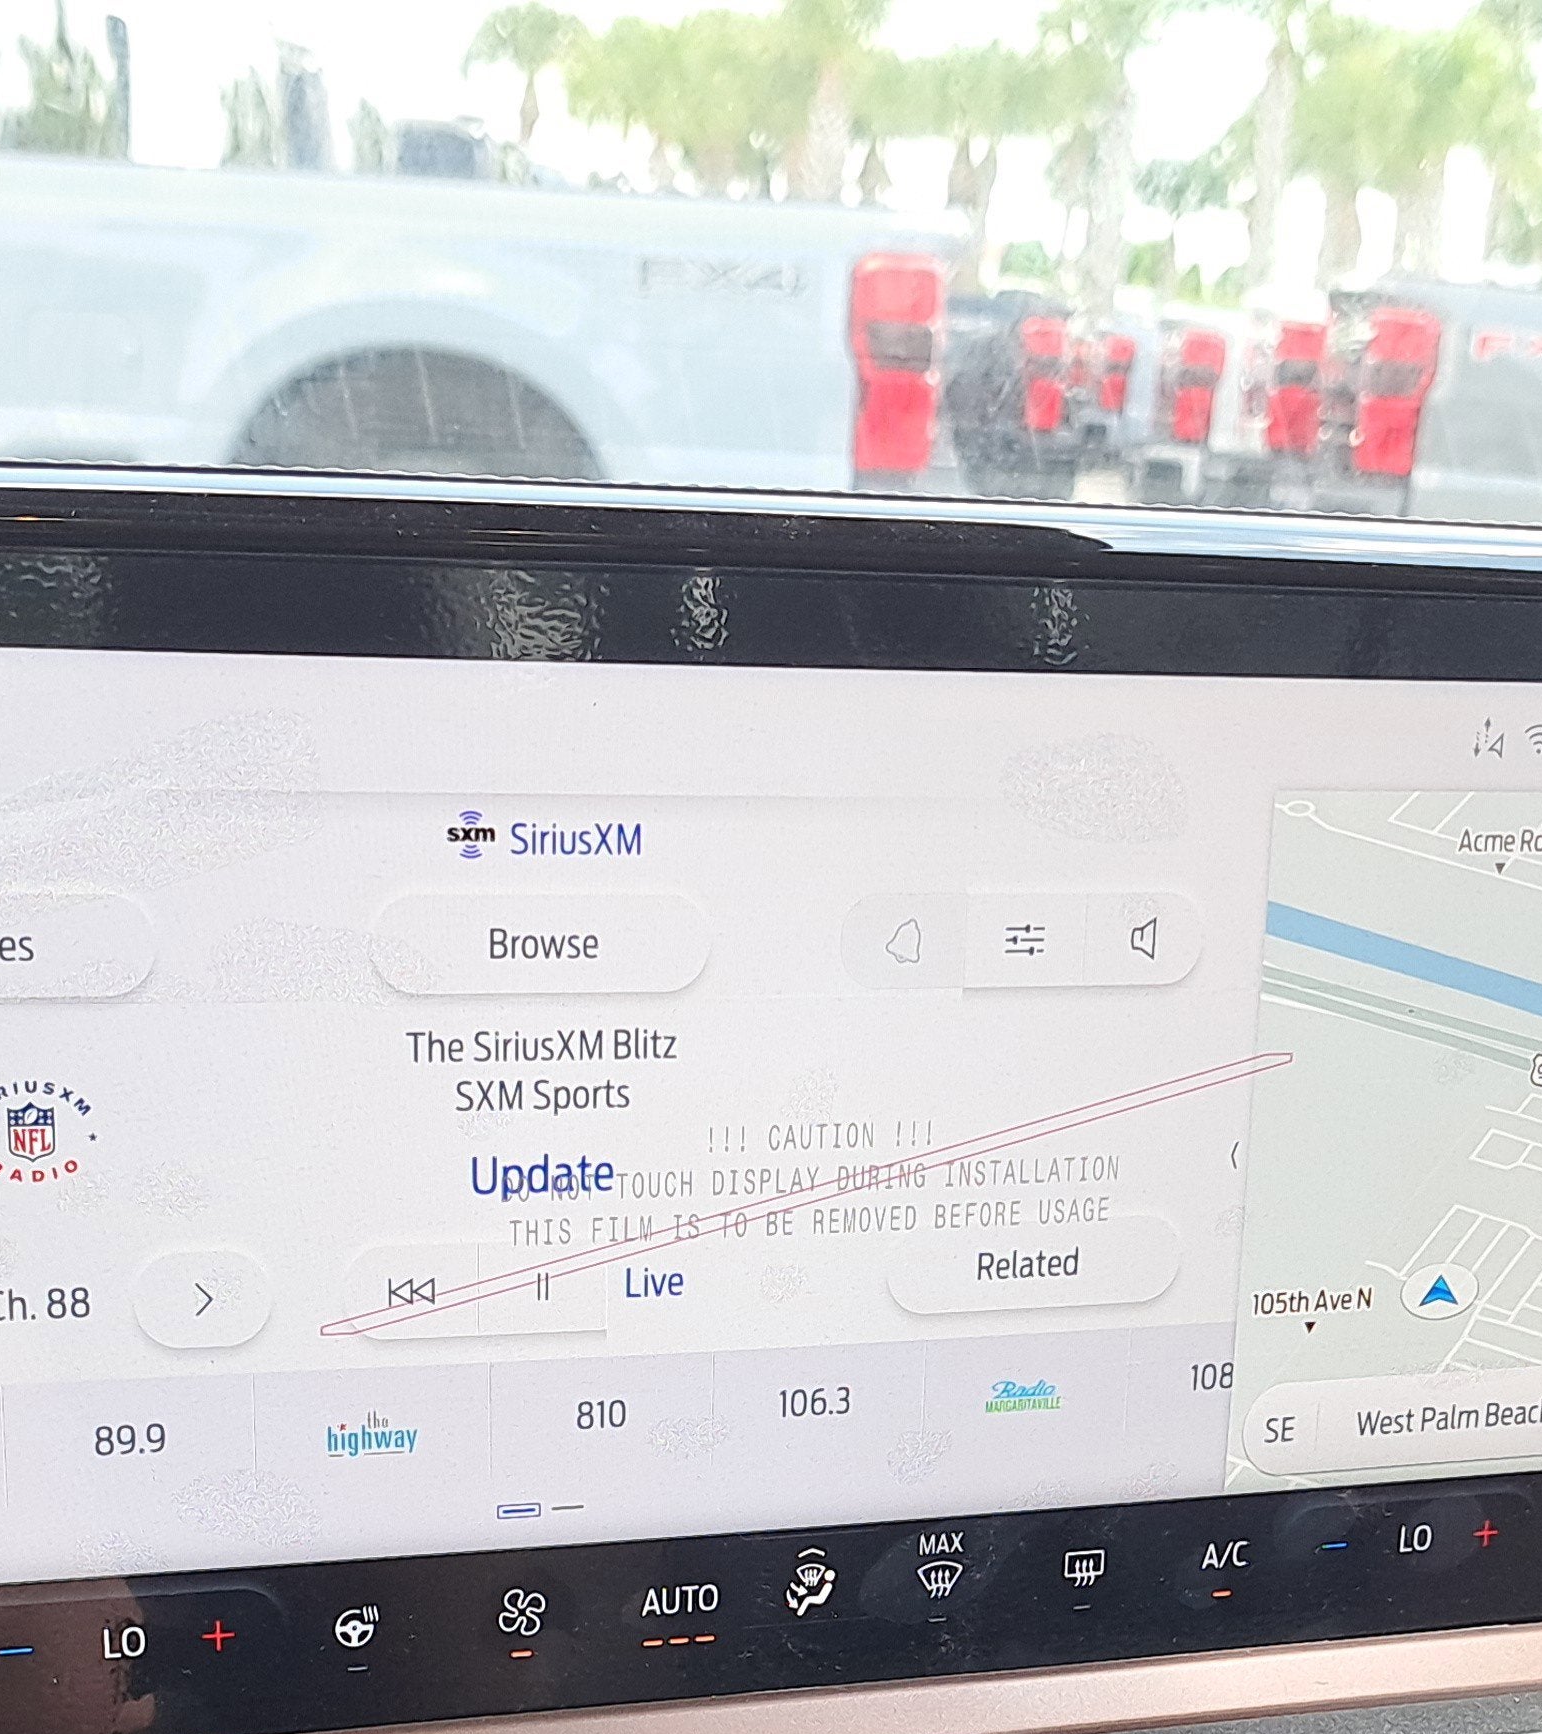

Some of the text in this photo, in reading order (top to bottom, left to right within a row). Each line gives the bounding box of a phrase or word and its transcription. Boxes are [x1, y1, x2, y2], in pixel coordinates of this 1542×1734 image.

[447, 826, 495, 842] sxm
[511, 823, 641, 855] SiriusXM
[1459, 829, 1515, 853] Acme
[490, 928, 599, 959] Browse
[406, 1028, 678, 1063] The SiriusXM Blitz
[456, 1079, 630, 1116] SXM Sports
[13, 1129, 51, 1155] NFL
[709, 1120, 932, 1152] !!! CAUTION !!!
[471, 1154, 613, 1200] Update
[617, 1171, 693, 1198] TOUCH
[712, 1166, 819, 1196] DISPLAY
[837, 1163, 925, 1191] DURING
[945, 1155, 1119, 1187] INSTALLATION
[510, 1197, 1109, 1246] THIS FILM IS TO BE REMOVED BEFORE USAGE
[977, 1246, 1079, 1281] Related
[625, 1268, 683, 1298] Live
[46, 1286, 90, 1318] 88
[1252, 1287, 1372, 1316] 105th Ave N
[779, 1386, 851, 1419] 106.3
[992, 1379, 1056, 1399] Radio
[367, 1410, 388, 1428] the
[576, 1398, 627, 1429] 810
[1264, 1416, 1295, 1443] SE
[1358, 1408, 1414, 1437] West
[1421, 1403, 1480, 1431] Palm
[94, 1422, 167, 1457] 89.9
[327, 1423, 418, 1456] highway
[920, 1531, 964, 1556] MAX
[1398, 1524, 1432, 1553] LO
[1202, 1540, 1249, 1571] A/C
[642, 1582, 719, 1619] AUTO
[103, 1626, 145, 1659] LO
